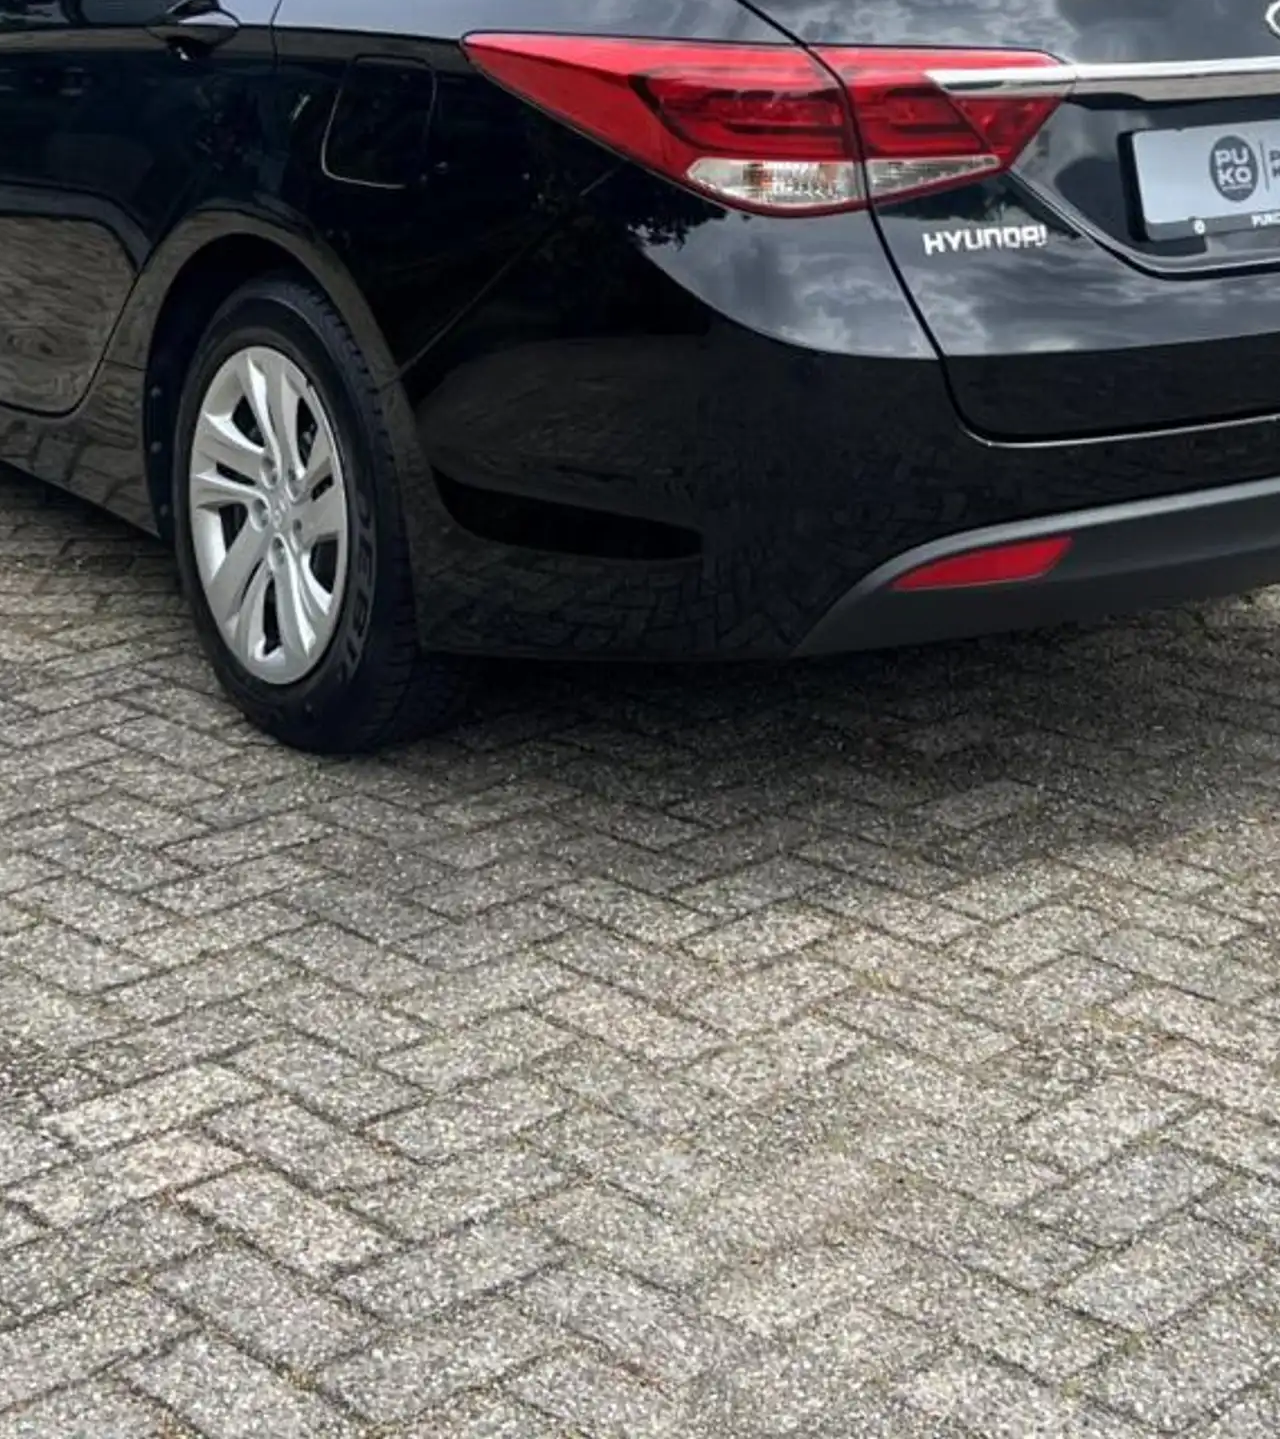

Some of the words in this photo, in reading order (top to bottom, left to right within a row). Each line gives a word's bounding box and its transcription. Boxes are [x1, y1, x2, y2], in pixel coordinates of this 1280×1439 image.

[1215, 146, 1250, 167] PU
[1217, 166, 1253, 185] KO
[922, 223, 1048, 256] HYUNDAI
